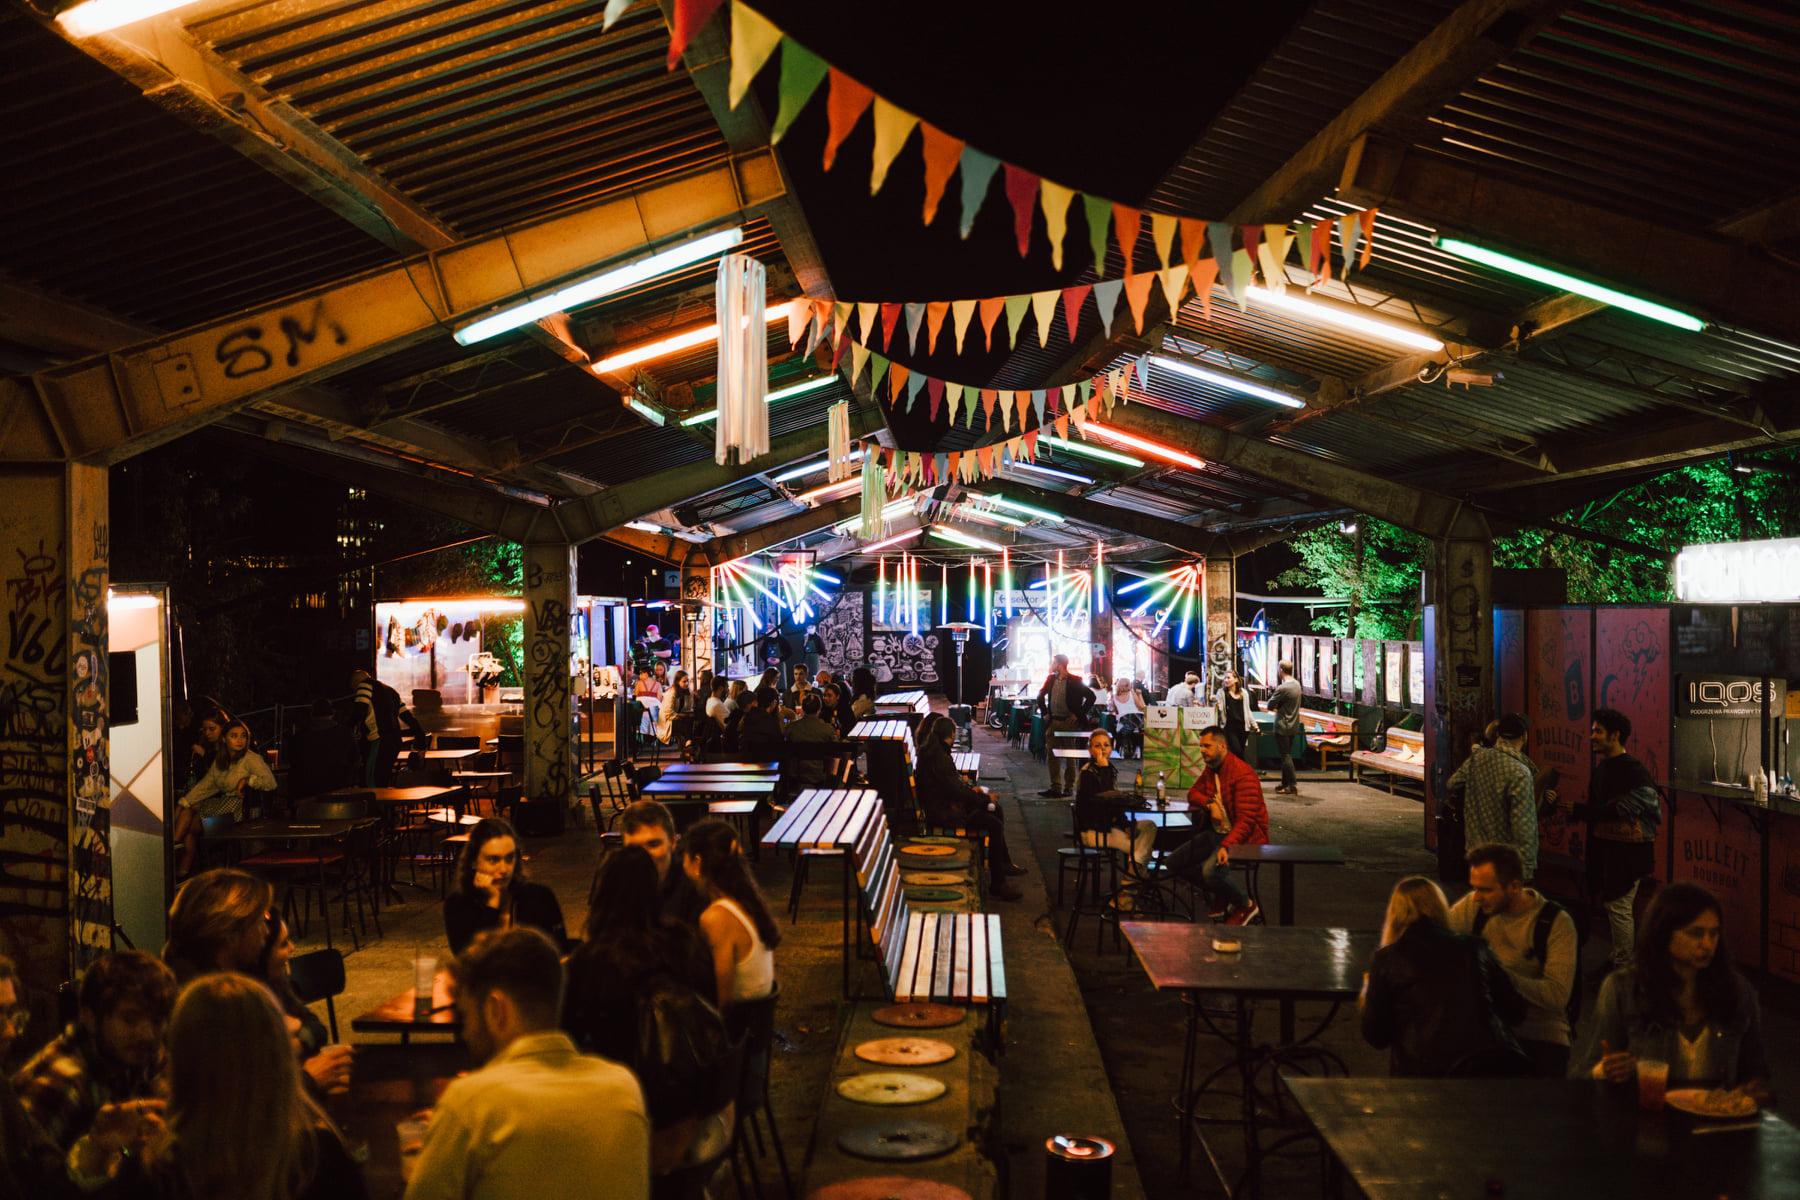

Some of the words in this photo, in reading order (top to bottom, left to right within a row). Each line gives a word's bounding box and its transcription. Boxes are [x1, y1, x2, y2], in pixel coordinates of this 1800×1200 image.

[1689, 681, 1777, 707] IQOS
[1536, 727, 1584, 752] BULLEIT
[1684, 840, 1750, 877] BULLEIT
